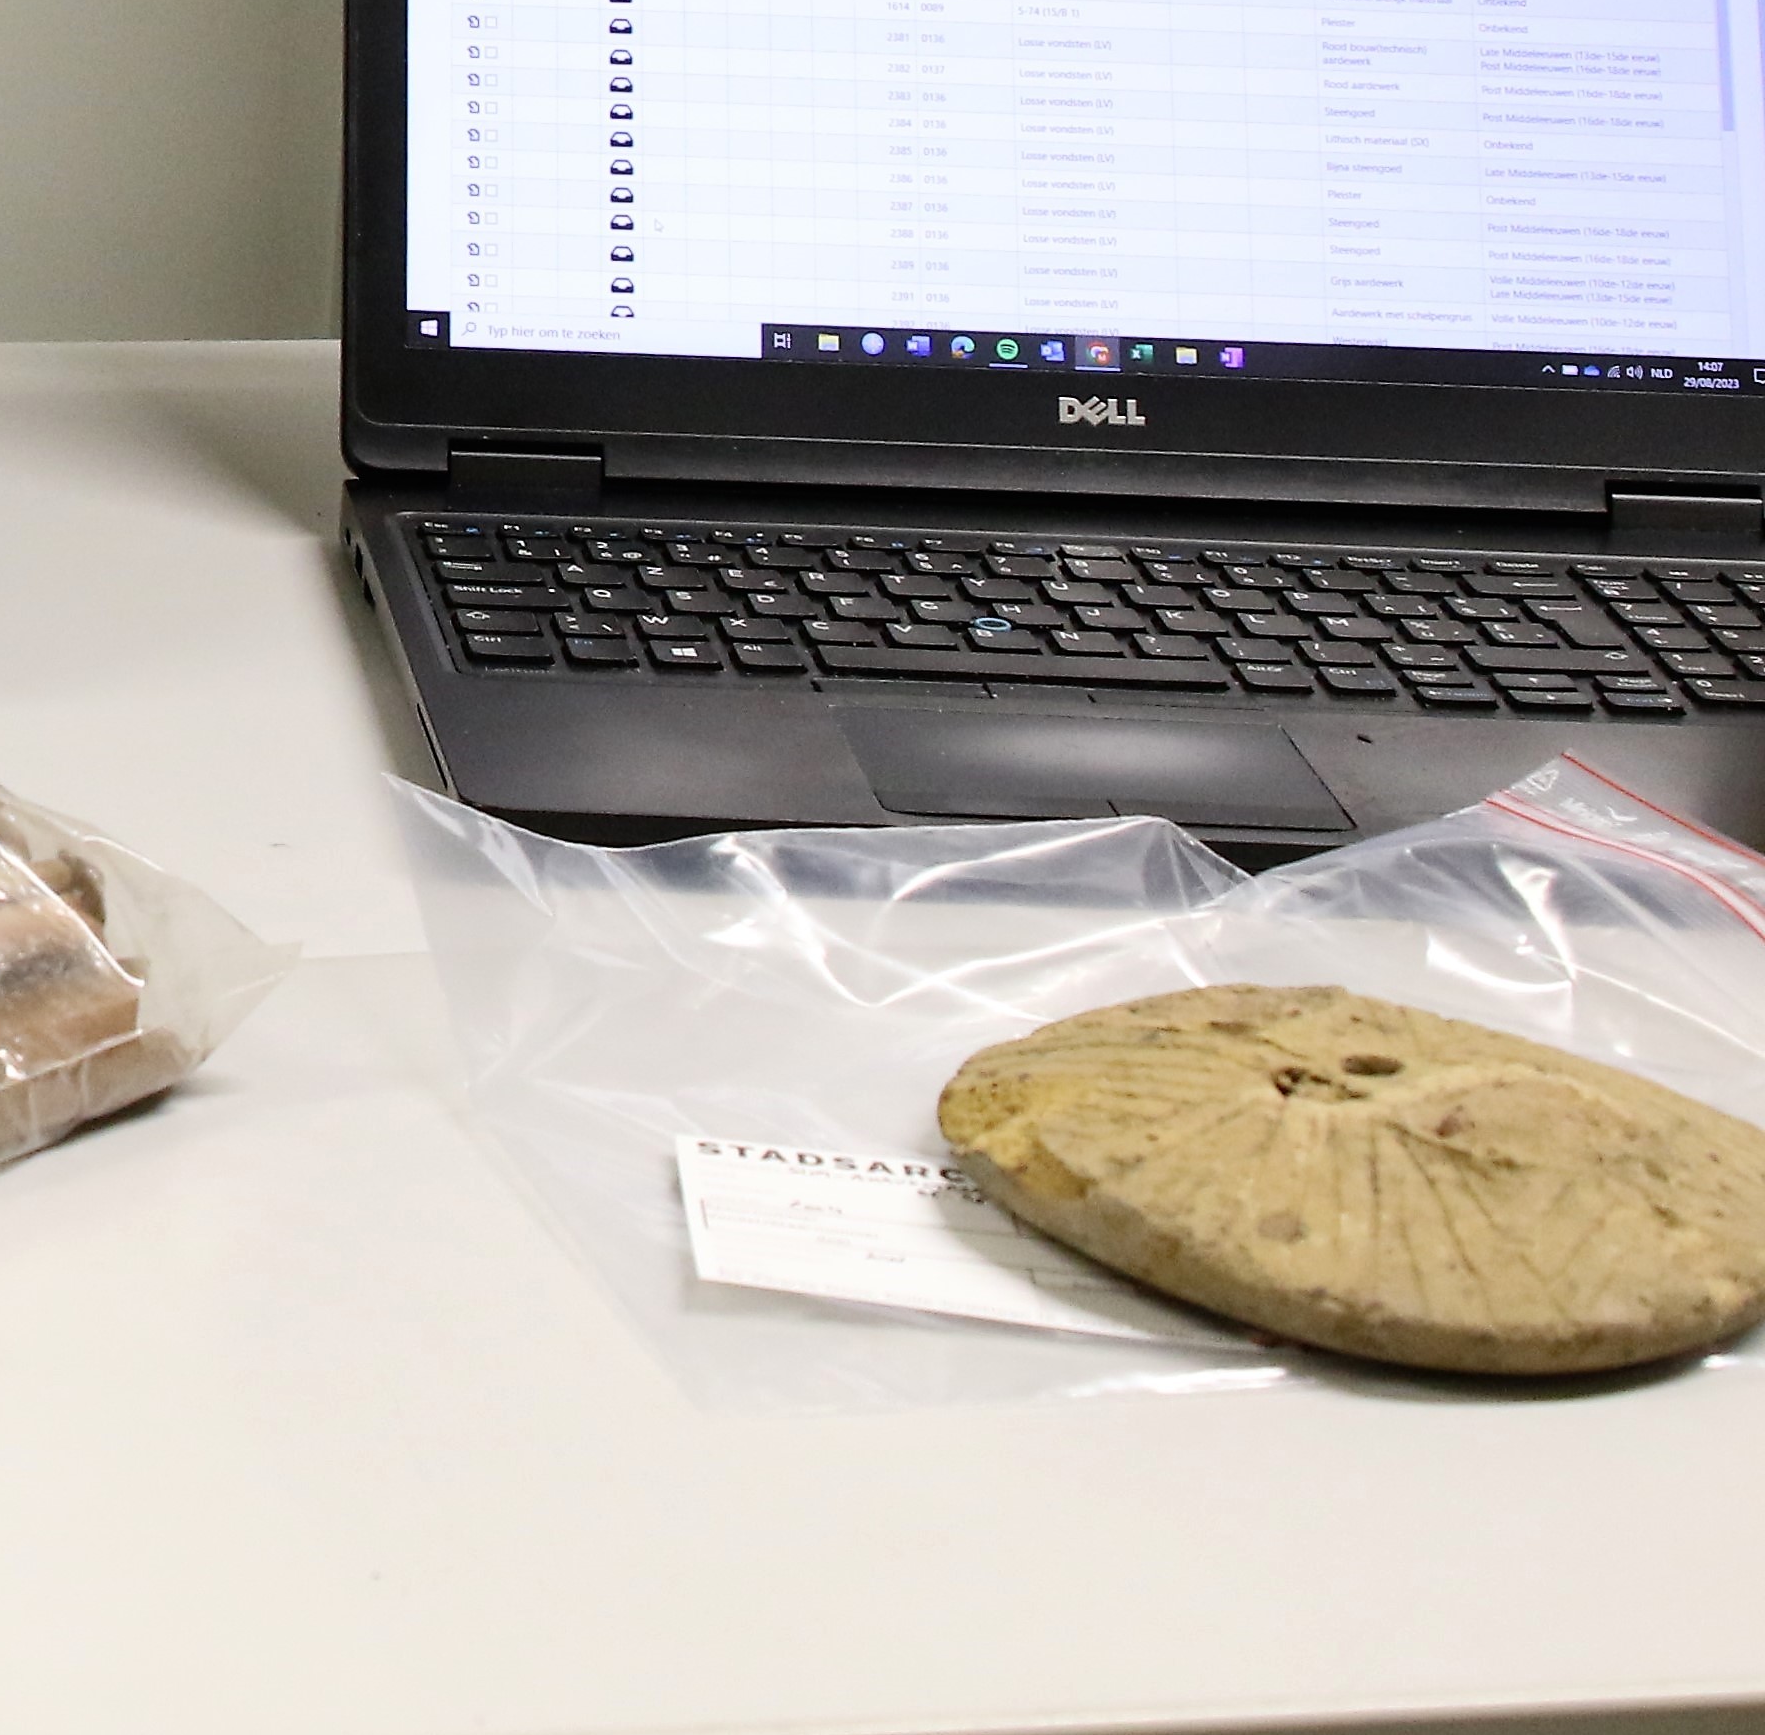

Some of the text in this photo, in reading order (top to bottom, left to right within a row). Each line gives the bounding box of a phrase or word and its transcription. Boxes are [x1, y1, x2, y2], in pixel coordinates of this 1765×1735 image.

[487, 324, 621, 341] Typ hier om te zoeken
[1650, 367, 1674, 379] NLD
[1058, 395, 1146, 427] DELL
